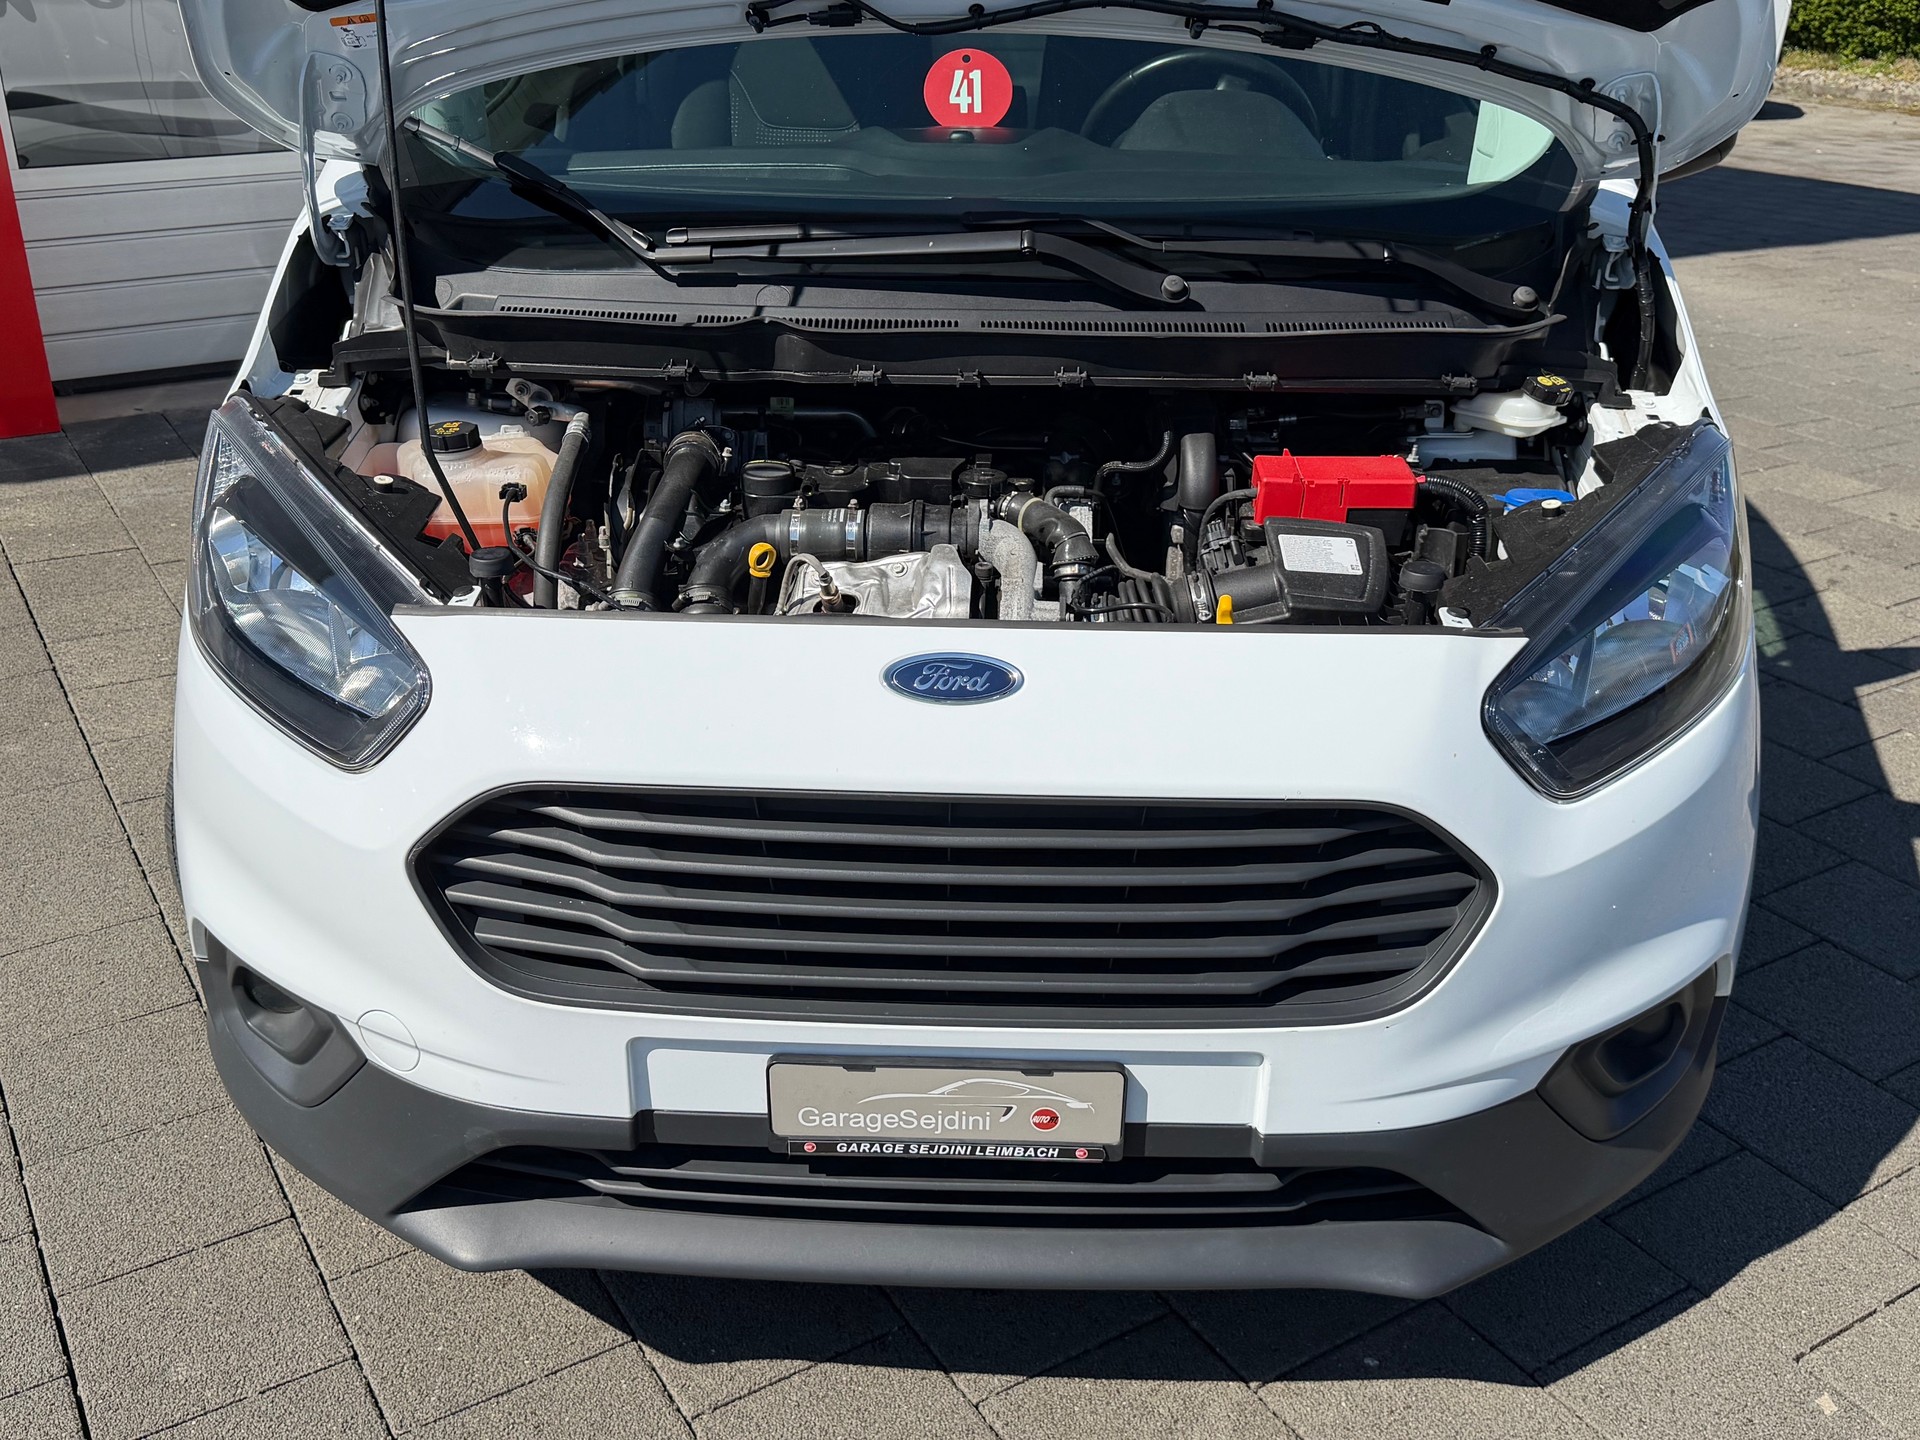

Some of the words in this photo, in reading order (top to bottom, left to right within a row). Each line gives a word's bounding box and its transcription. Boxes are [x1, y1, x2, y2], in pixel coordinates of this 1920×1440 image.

[949, 69, 982, 113] 41
[914, 663, 992, 692] Ford
[797, 1106, 991, 1134] GarageSejdini
[836, 1142, 904, 1154] GARAGE
[908, 1143, 972, 1156] SEJDINI
[975, 1145, 1059, 1158] LEIMBACH
